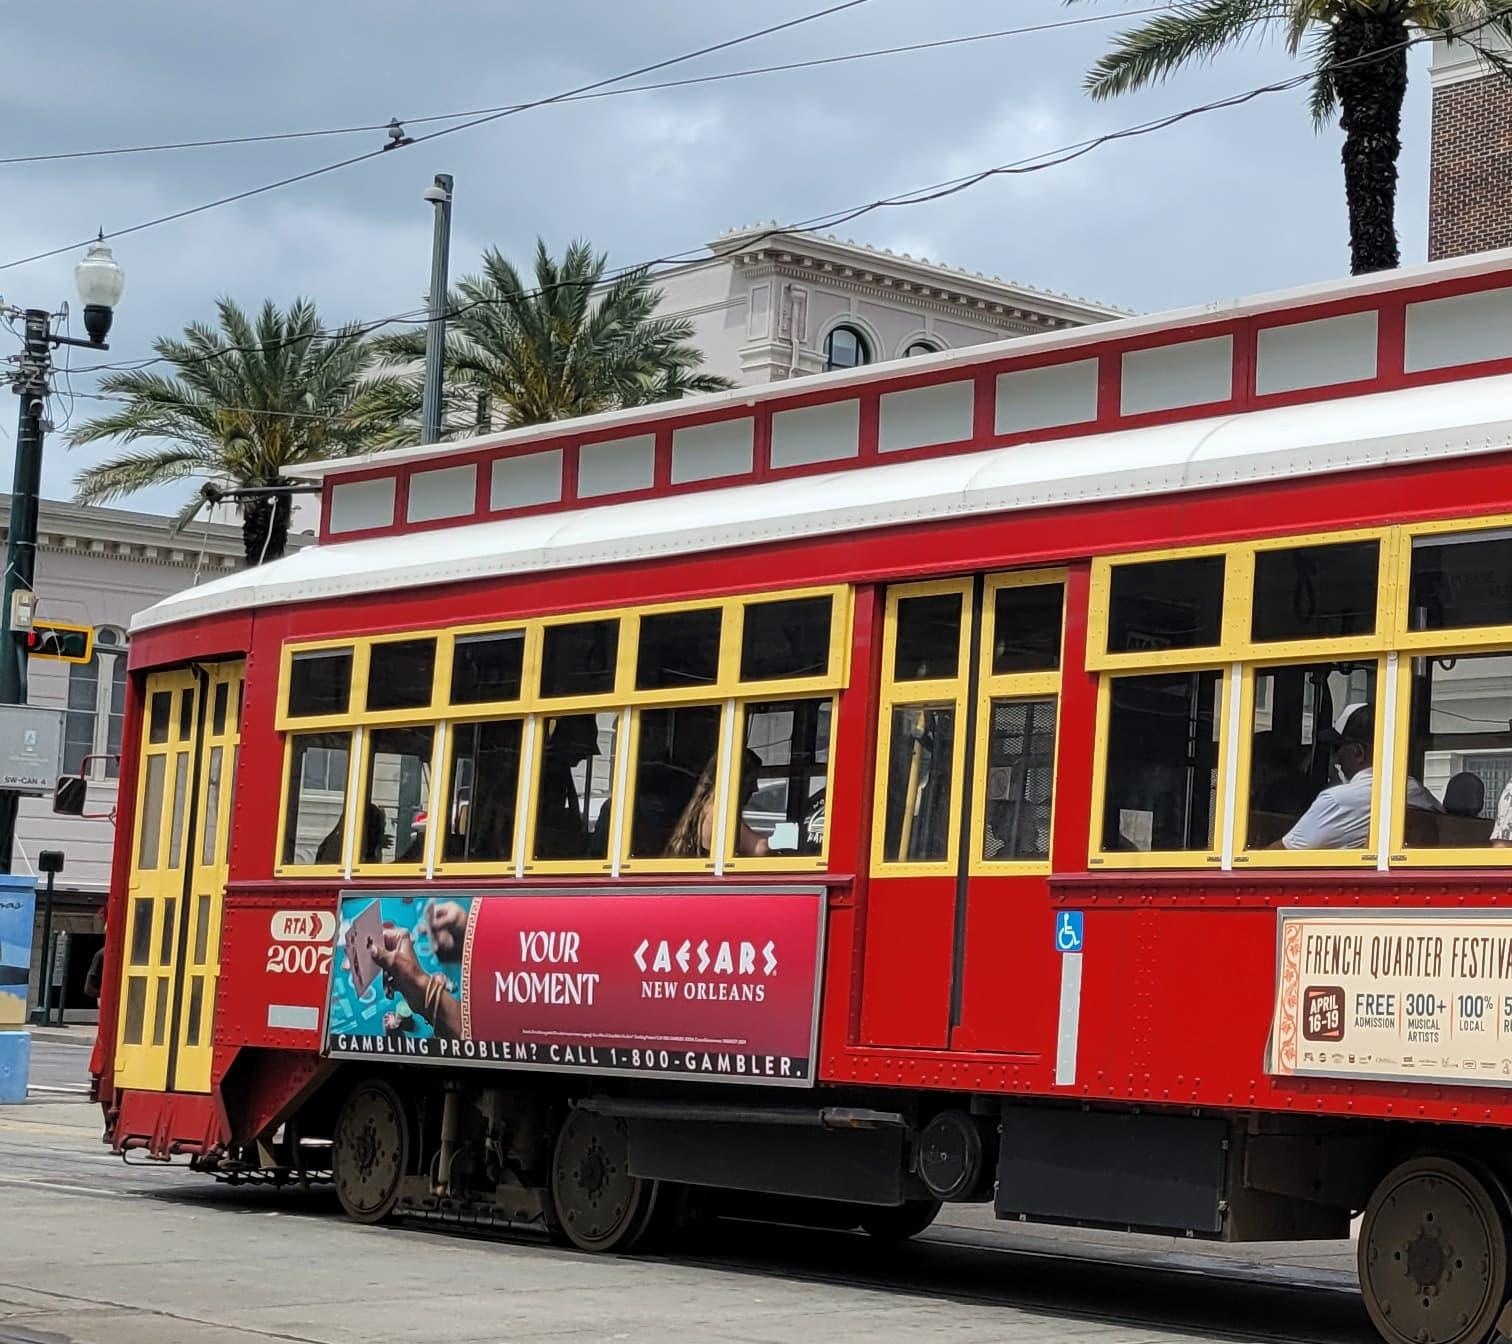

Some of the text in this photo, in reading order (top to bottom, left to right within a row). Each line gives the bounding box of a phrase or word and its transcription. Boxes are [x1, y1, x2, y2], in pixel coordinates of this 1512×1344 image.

[284, 918, 307, 934] RTA
[519, 931, 580, 963] YOUR
[634, 939, 777, 975] CAESARS
[1305, 935, 1363, 976] FRENCH
[1370, 936, 1443, 979] QUARTER
[266, 945, 333, 974] 2007
[495, 971, 599, 1005] MOMENT
[641, 981, 765, 1002] NEW ORLEANS
[1310, 994, 1338, 1014] APRIL
[1356, 993, 1395, 1016] FREE
[1405, 993, 1447, 1017] 300+
[1458, 995, 1493, 1018] 100%
[1308, 1009, 1339, 1033] 16-19
[1354, 1017, 1395, 1029] ADMISSION
[1407, 1019, 1440, 1031] MUSICAL
[1459, 1020, 1485, 1032] LOCAL
[1407, 1031, 1439, 1043] ARTISTS
[338, 1035, 801, 1076] GAMBLING PROBLEM? CALL 1-800-GAMBLER.
